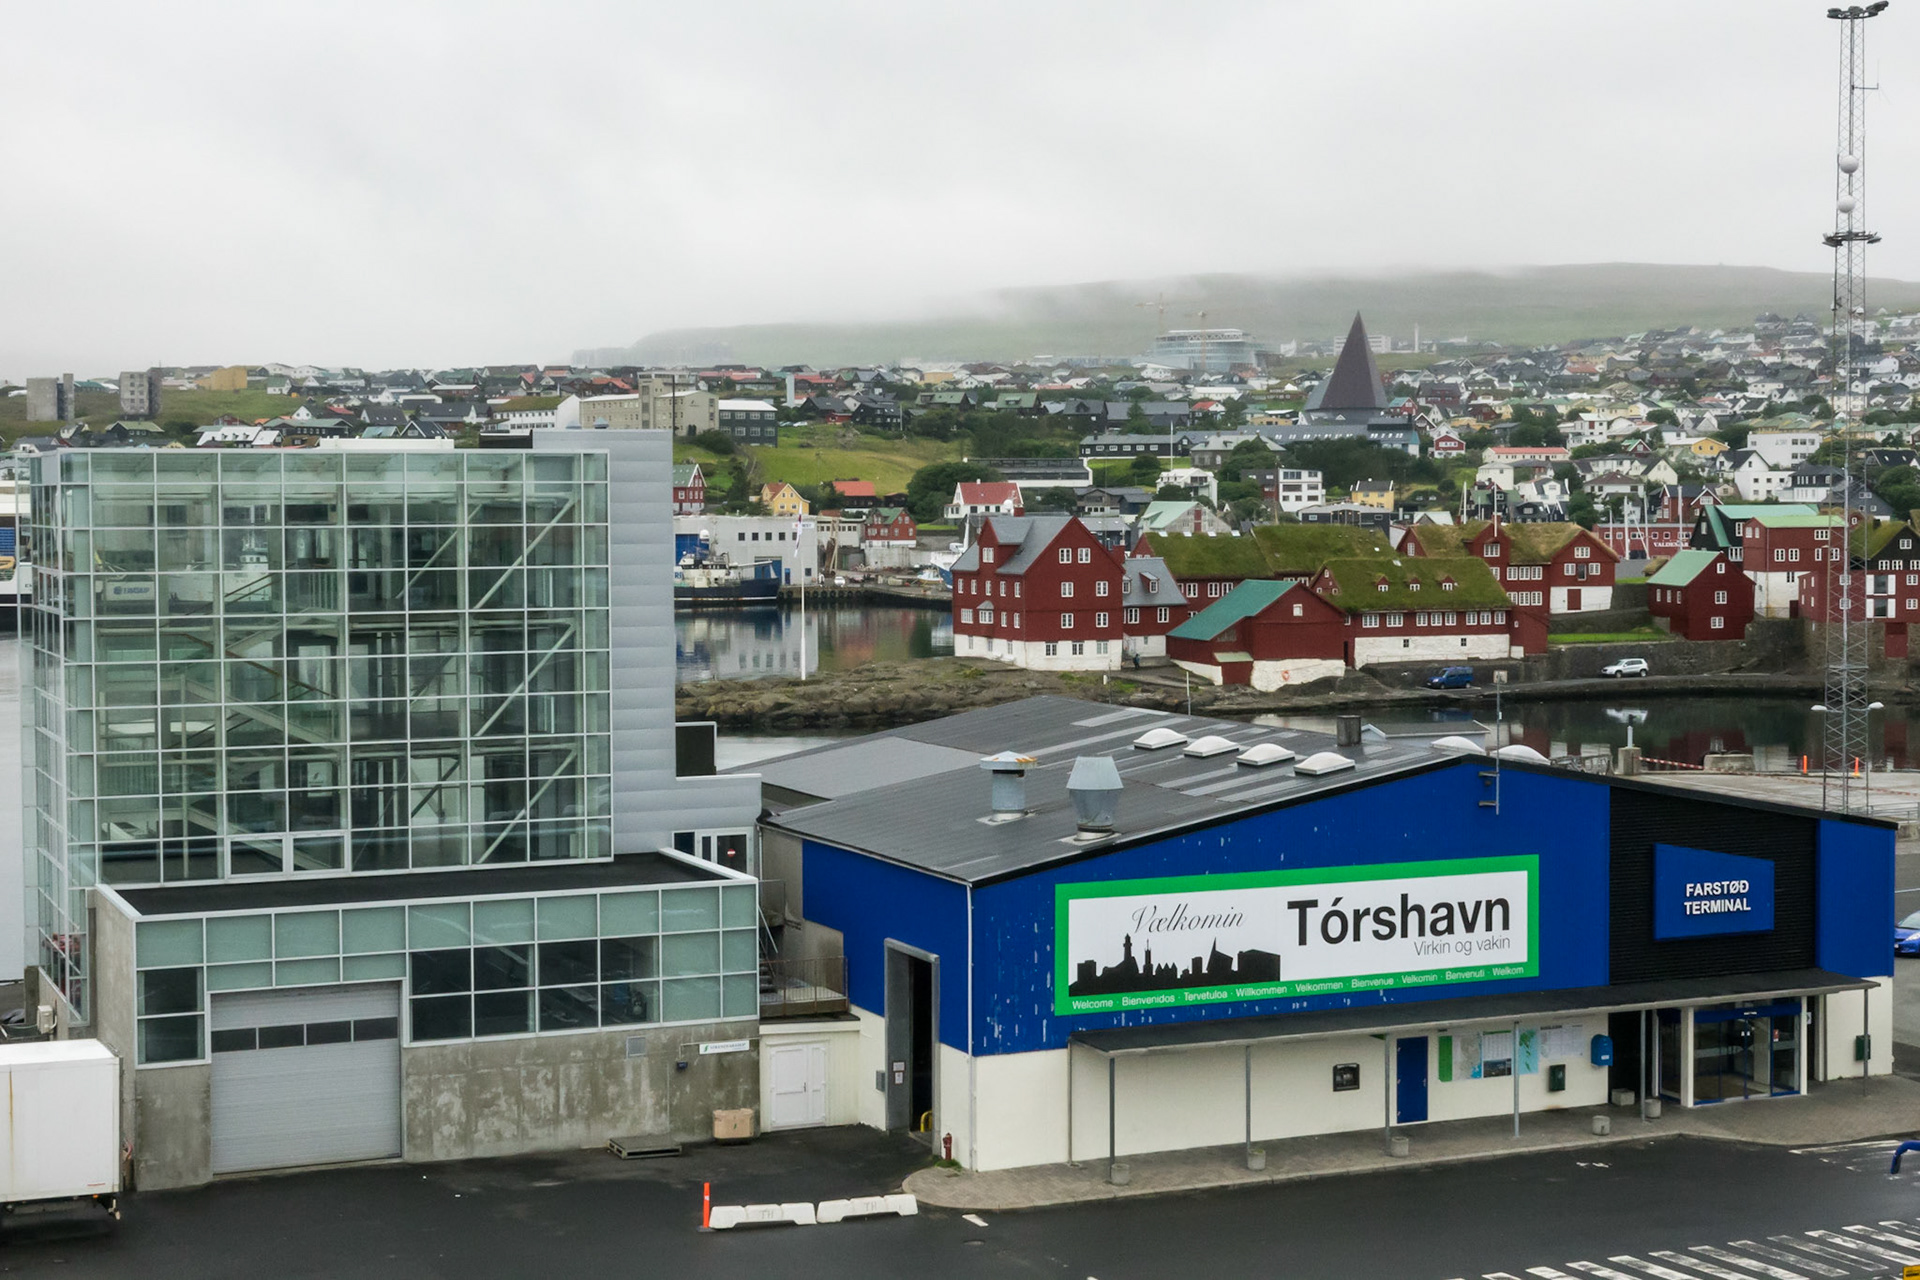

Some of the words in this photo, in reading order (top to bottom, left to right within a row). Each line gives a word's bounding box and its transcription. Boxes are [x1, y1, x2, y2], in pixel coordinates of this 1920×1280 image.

[1131, 902, 1245, 934] Vælkomin
[1286, 893, 1511, 947] Tórshavn
[1683, 897, 1752, 916] TERMINAL
[1413, 939, 1451, 957] Virkin
[1455, 941, 1472, 956] og
[1476, 936, 1511, 951] vakin
[1072, 999, 1114, 1011] Welcome
[1121, 993, 1176, 1007] Bienvenidos
[1183, 989, 1229, 1002] Tervetuloa
[1235, 984, 1288, 998] Willkommen
[1295, 981, 1344, 993] Velkommen
[1351, 977, 1395, 989] Bienvenue
[1401, 972, 1438, 985] Velkomin
[1445, 968, 1485, 981] Benvenuti
[1492, 966, 1525, 977] Welkom
